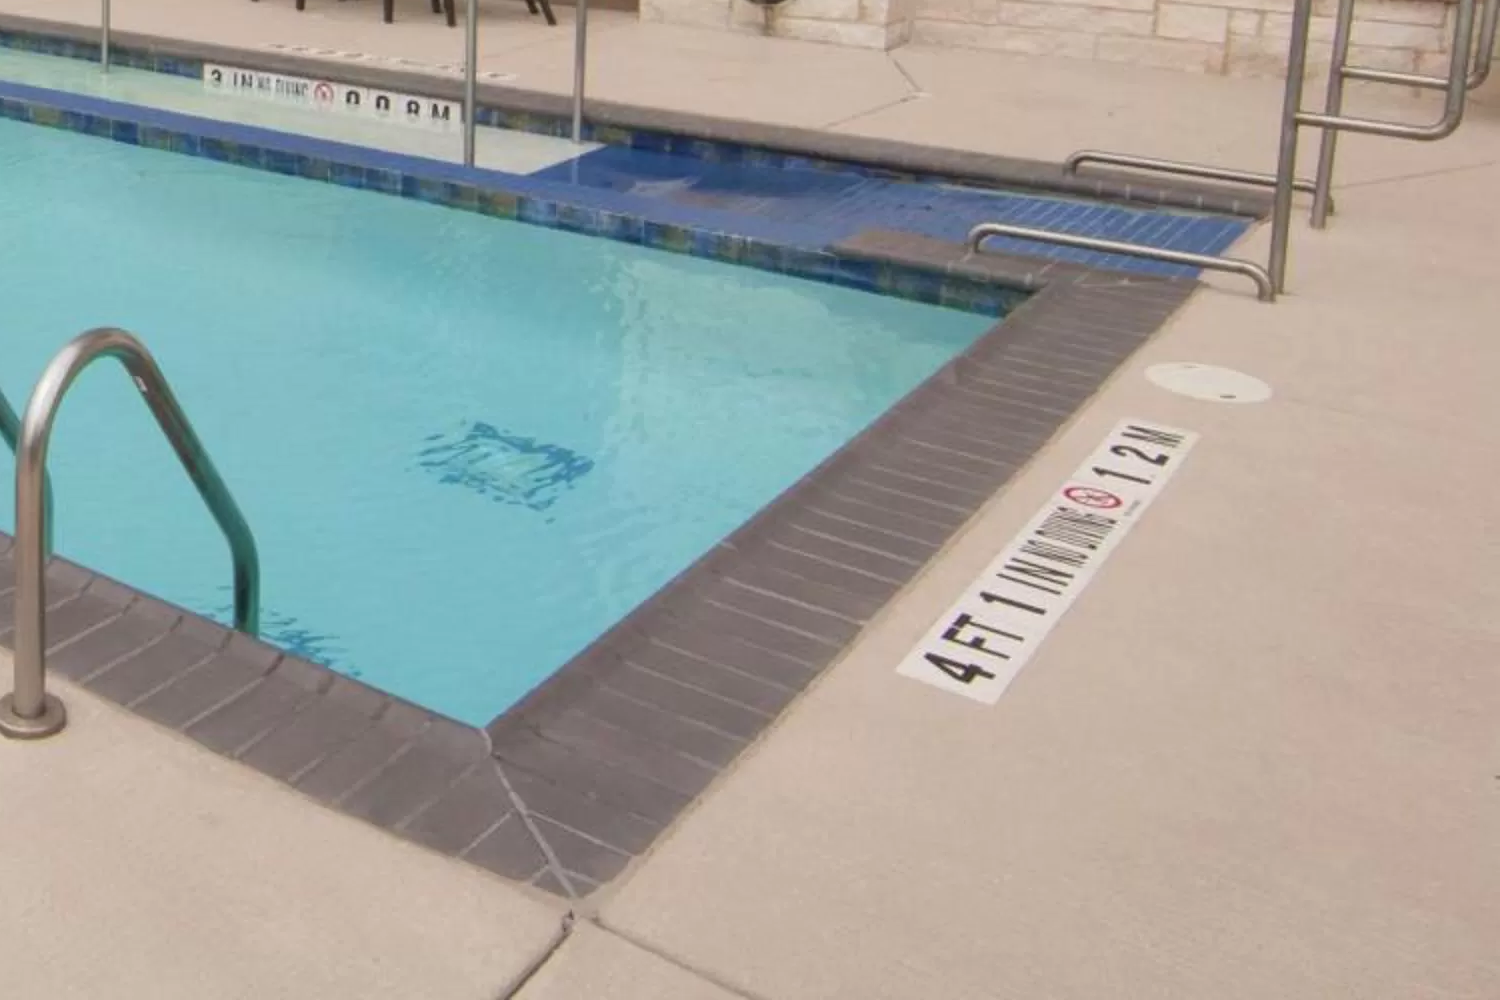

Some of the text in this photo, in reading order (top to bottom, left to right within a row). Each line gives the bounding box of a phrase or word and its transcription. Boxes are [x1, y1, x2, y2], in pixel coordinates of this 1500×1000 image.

[996, 557, 1075, 595] IN
[979, 591, 1047, 615] 1
[940, 613, 1025, 660] FT
[923, 652, 996, 684] 4
